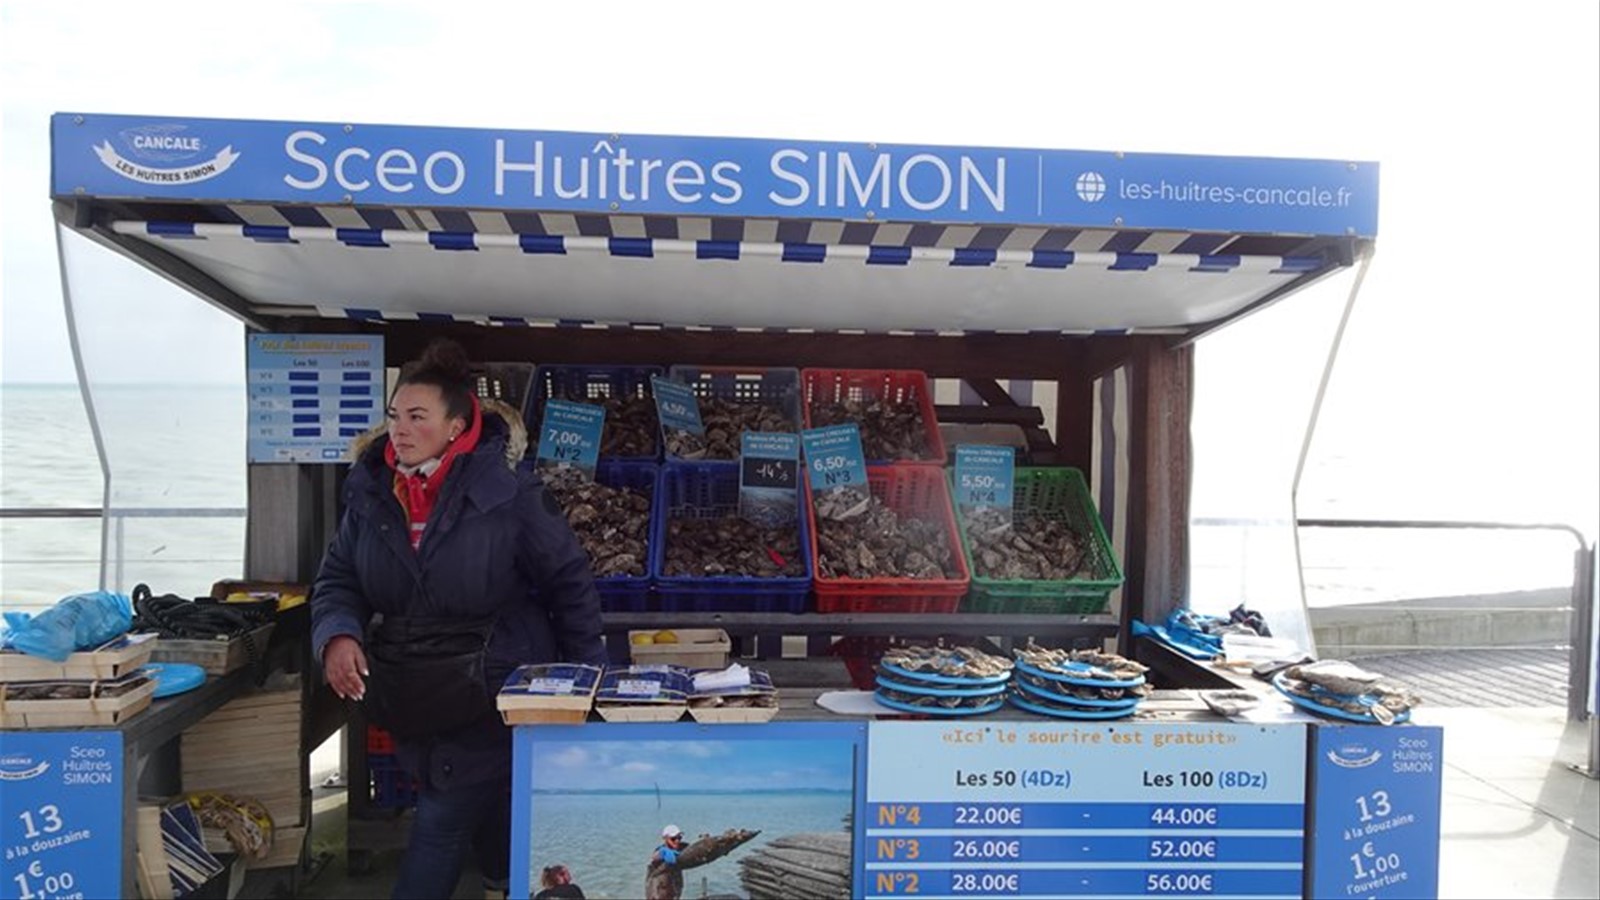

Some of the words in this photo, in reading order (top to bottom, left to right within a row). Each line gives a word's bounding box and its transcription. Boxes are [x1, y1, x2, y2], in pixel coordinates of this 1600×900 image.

[134, 135, 200, 150] CANCALE
[116, 160, 134, 175] LES
[137, 168, 181, 182] HUÎTRES
[184, 164, 215, 179] SIMON
[283, 130, 466, 195] Sceo
[495, 139, 744, 205] Huîtres
[768, 149, 1006, 212] SIMON
[554, 446, 582, 461] N°2
[824, 470, 852, 485] N°3
[997, 729, 1017, 744] le
[1028, 730, 1101, 744] sourire
[1112, 731, 1142, 745] est
[1398, 737, 1428, 749] Sceo
[71, 746, 106, 758] Sceo
[1392, 749, 1433, 761] Huîtres
[63, 759, 112, 771] Huîtres
[1393, 761, 1433, 773] SIMON
[63, 772, 112, 785] SIMON
[956, 770, 989, 786] Les
[992, 770, 1016, 786] 50
[1021, 770, 1071, 789] (4Dz)
[1143, 771, 1174, 787] Les
[1179, 771, 1214, 787] 100
[1218, 771, 1268, 790] (8Dz)
[878, 805, 921, 825] N°4
[955, 807, 1021, 824] 22.00€
[1151, 808, 1216, 825] 44.00€
[1356, 791, 1391, 821] 13
[20, 804, 63, 839] 13
[1352, 828, 1363, 838] la
[1365, 814, 1414, 834] douzaine
[15, 846, 29, 856] la
[31, 829, 91, 852] douzaine
[877, 838, 920, 859] N°3
[953, 840, 1020, 857] 26.00€
[1150, 840, 1215, 857] 52.00€
[876, 872, 919, 893] N°2
[952, 874, 1018, 891] 28.00€
[1147, 874, 1212, 891] 56.00€
